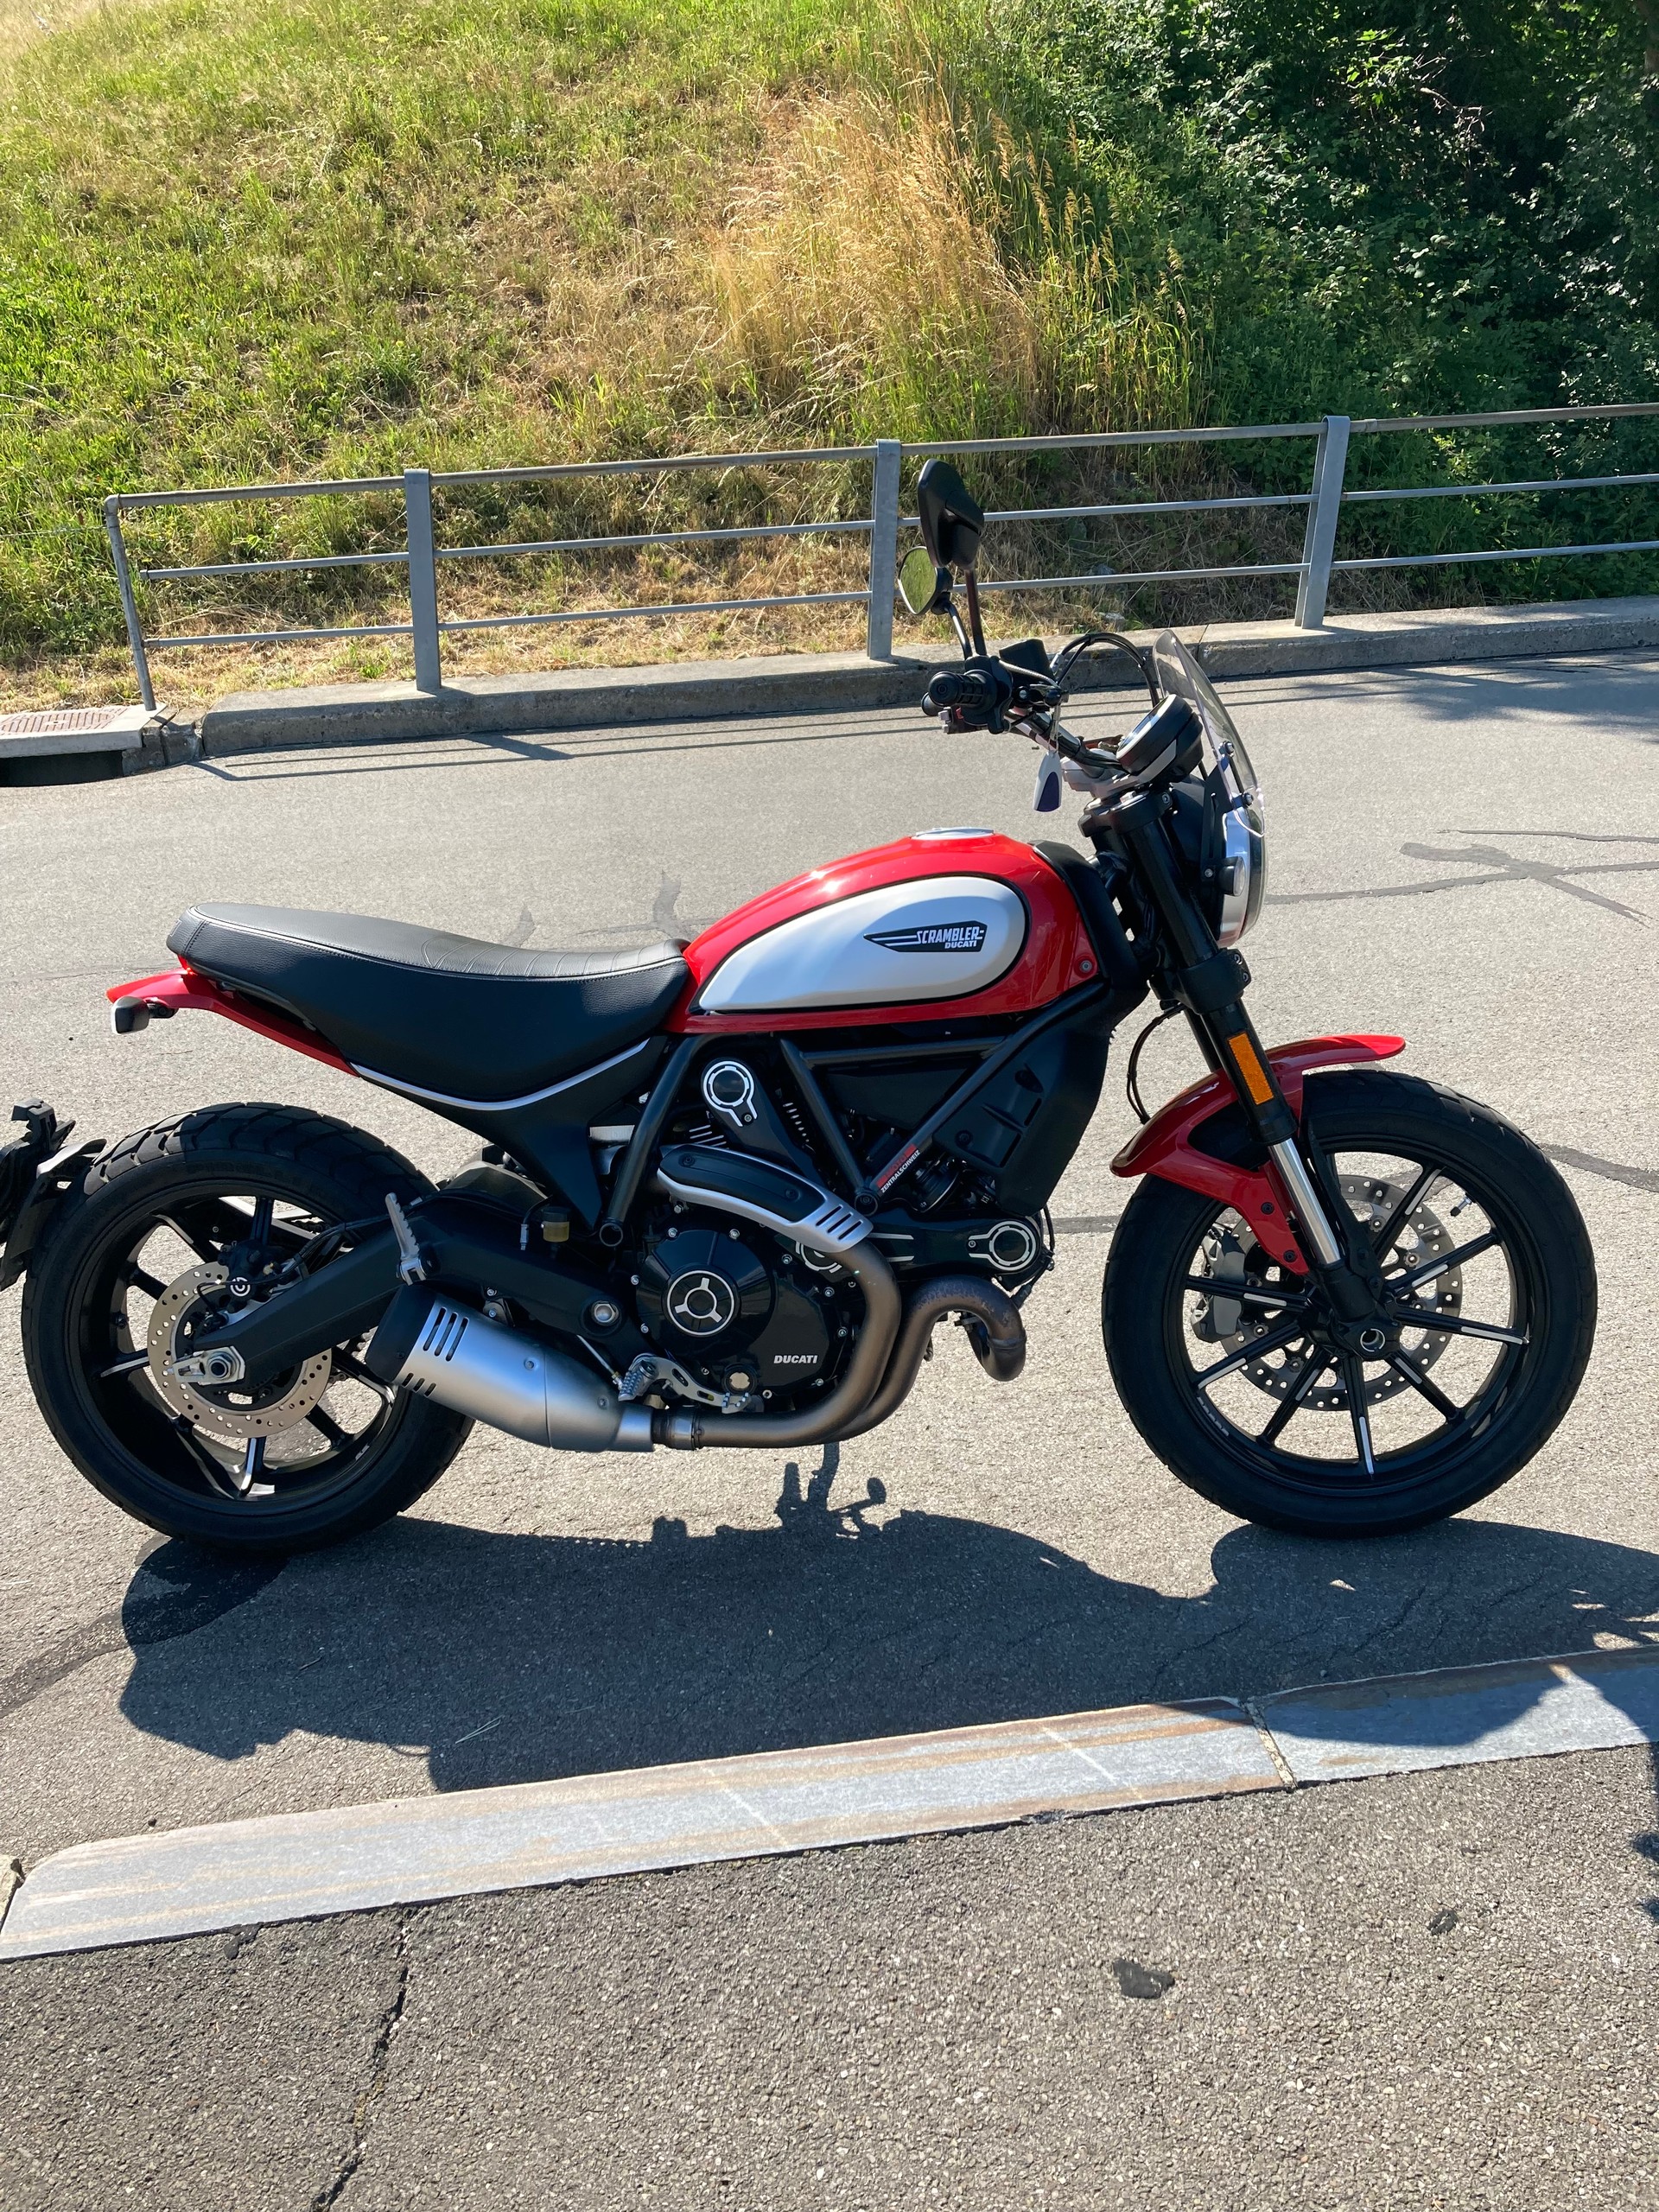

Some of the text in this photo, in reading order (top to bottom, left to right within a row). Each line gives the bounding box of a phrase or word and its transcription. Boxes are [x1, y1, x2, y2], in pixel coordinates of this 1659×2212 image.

[916, 926, 983, 944] SCRAMBLER
[944, 940, 977, 949] DUCATI
[880, 1149, 920, 1193] ZENTRALSCHWEIZ
[773, 1355, 818, 1363] DUCATI
